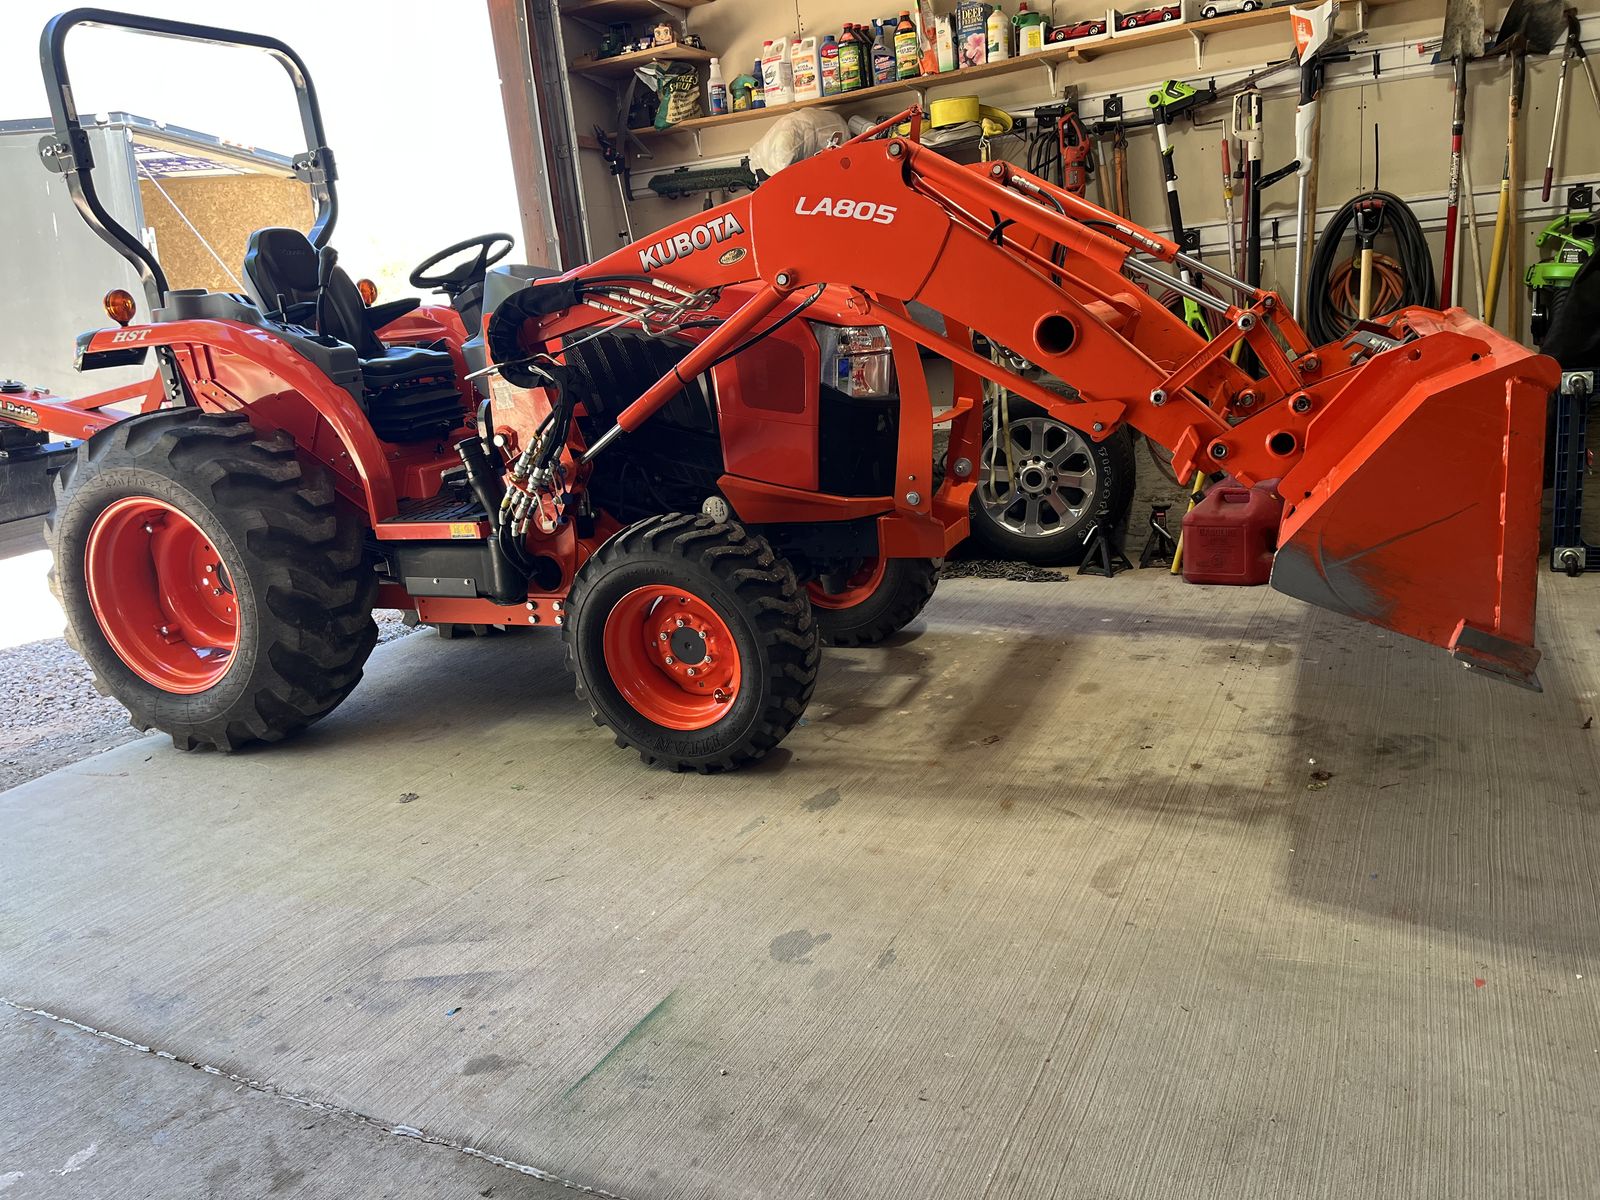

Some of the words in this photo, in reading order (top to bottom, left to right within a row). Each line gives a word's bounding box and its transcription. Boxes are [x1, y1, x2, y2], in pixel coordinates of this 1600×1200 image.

[962, 7, 984, 20] DEEP
[795, 196, 898, 225] LA805
[638, 212, 745, 273] KUBOTA
[112, 329, 152, 343] HST
[7, 402, 38, 418] Pride
